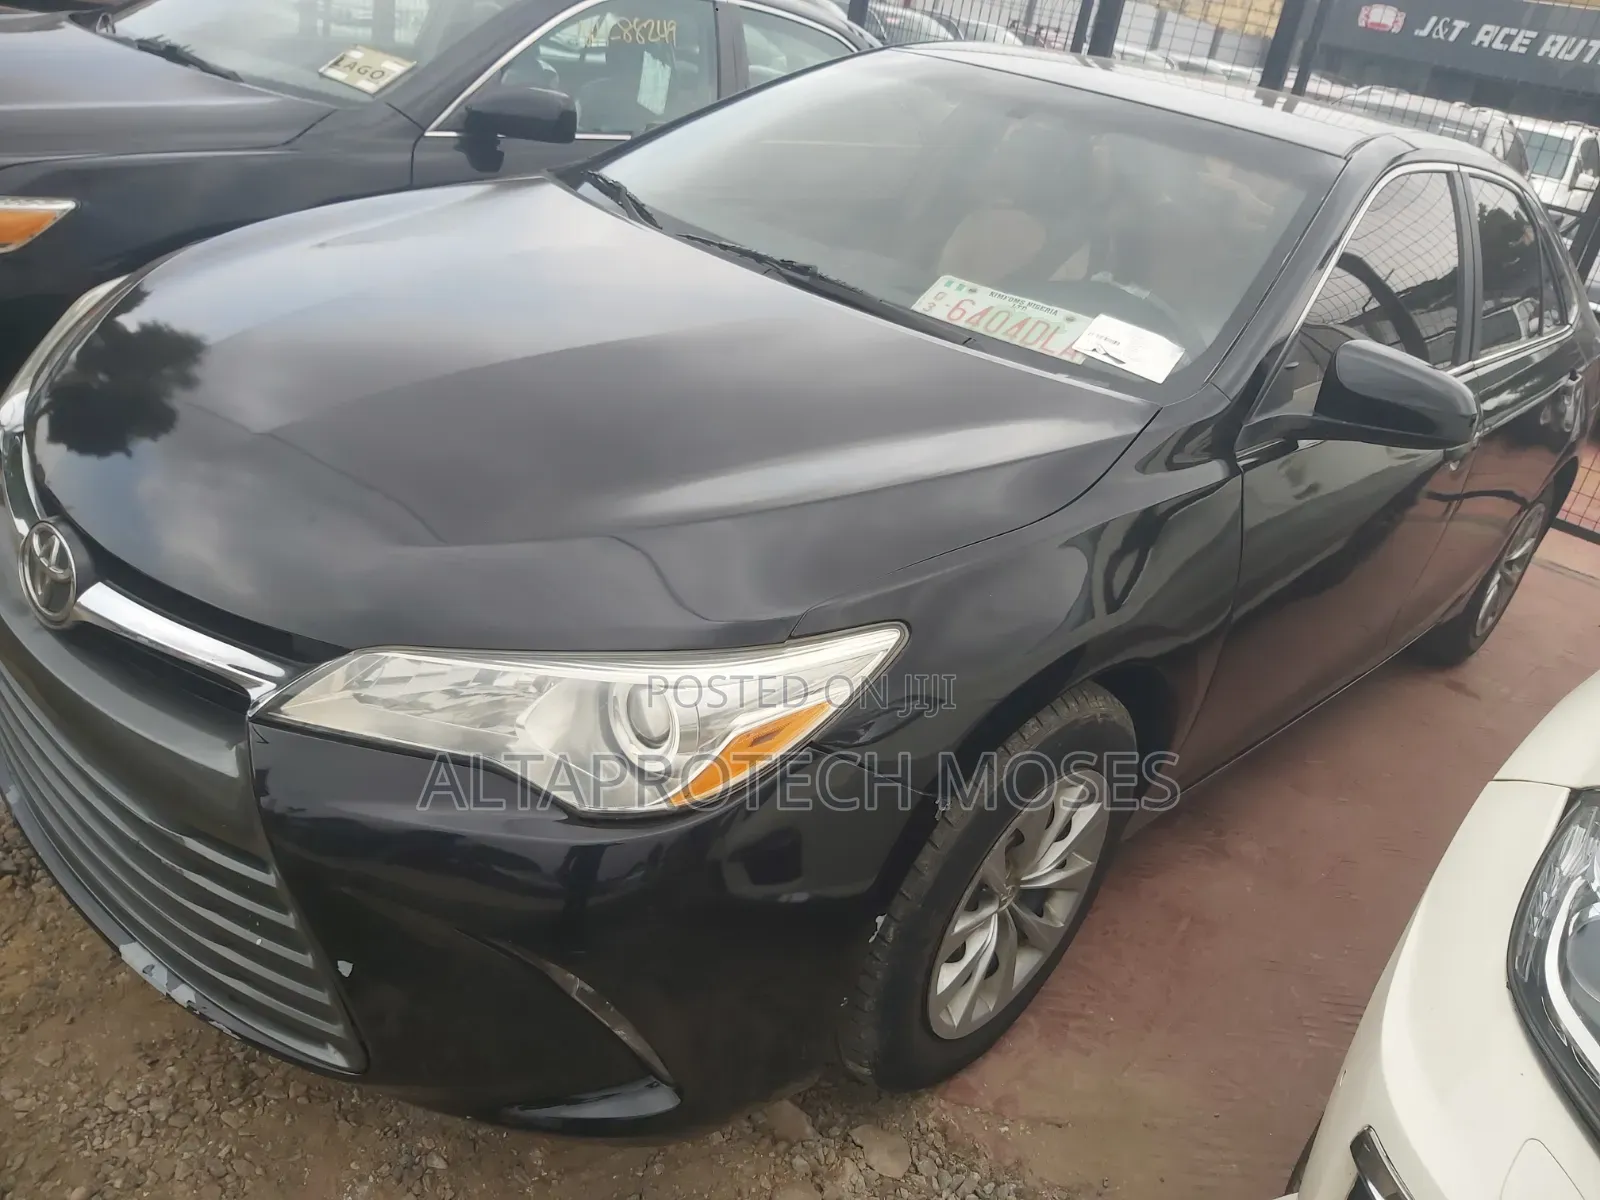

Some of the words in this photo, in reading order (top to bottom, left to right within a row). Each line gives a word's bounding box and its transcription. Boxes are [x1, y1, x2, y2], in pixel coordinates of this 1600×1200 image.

[1414, 15, 1470, 43] J&T
[1471, 24, 1539, 54] ACE
[1537, 34, 1600, 65] AUT
[328, 54, 389, 81] LAGO
[1026, 301, 1060, 317] NIGERIA
